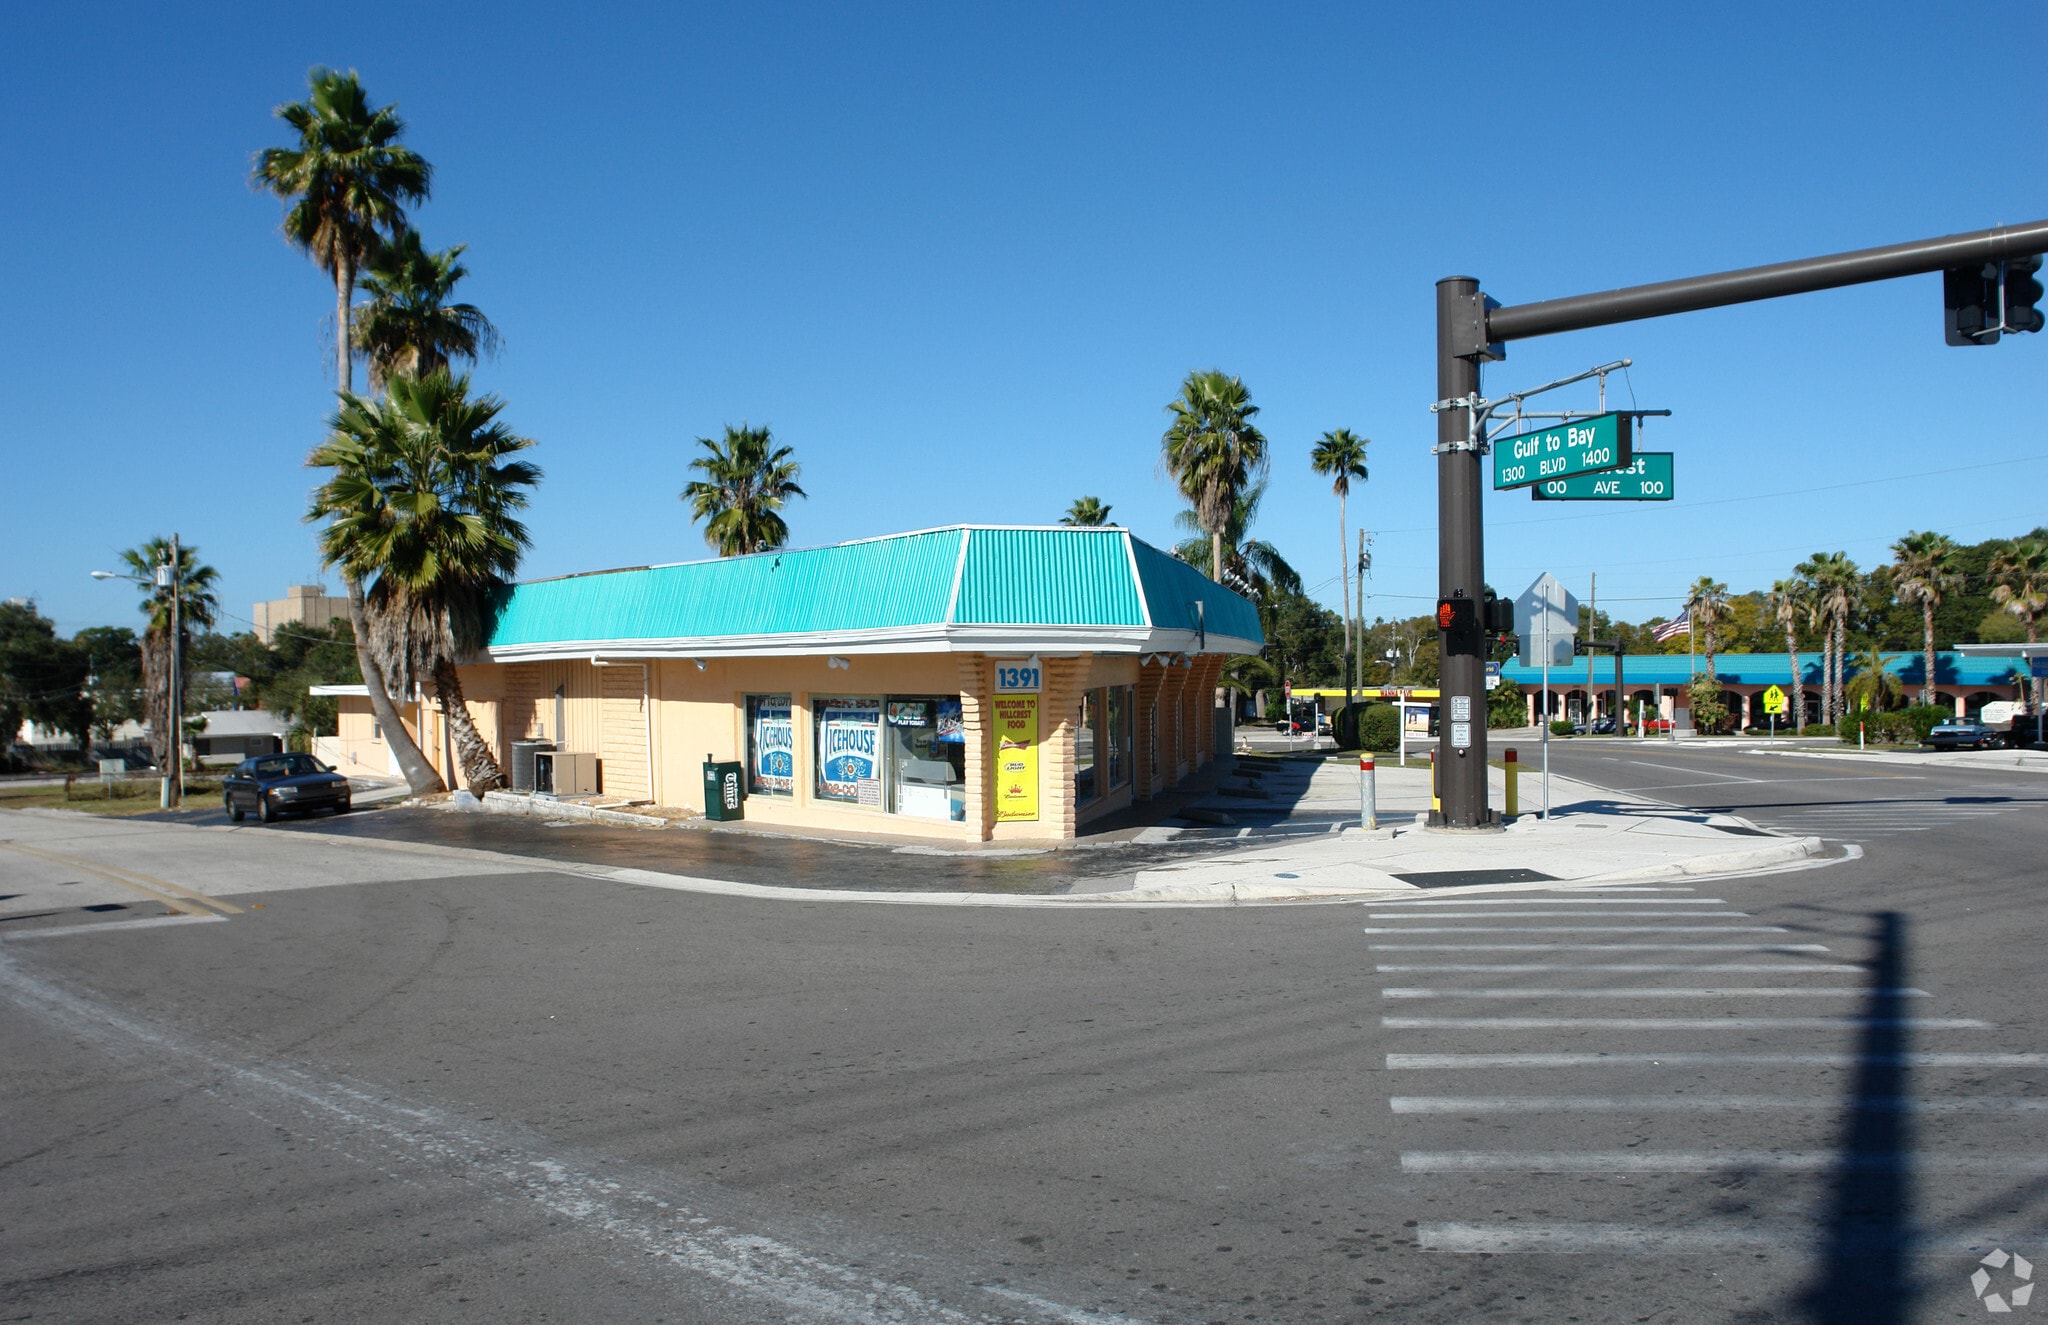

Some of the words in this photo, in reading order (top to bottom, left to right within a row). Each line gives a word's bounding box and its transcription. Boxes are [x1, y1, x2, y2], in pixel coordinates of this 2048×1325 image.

[1513, 436, 1540, 459] Gulf
[1545, 433, 1560, 452] to
[1567, 427, 1596, 448] Bay
[1502, 465, 1526, 483] 1300
[1539, 457, 1567, 476] BLVD
[1581, 447, 1610, 467] 1400
[1593, 481, 1621, 494] AVE
[1640, 481, 1664, 494] 100
[998, 668, 1039, 687] 1391
[995, 700, 1025, 709] WELCOME
[1026, 700, 1036, 709] TO
[999, 710, 1031, 719] HILLCREST
[1007, 720, 1026, 729] FOOD
[829, 728, 876, 757] ICEHOUSE
[725, 772, 737, 809] Times
